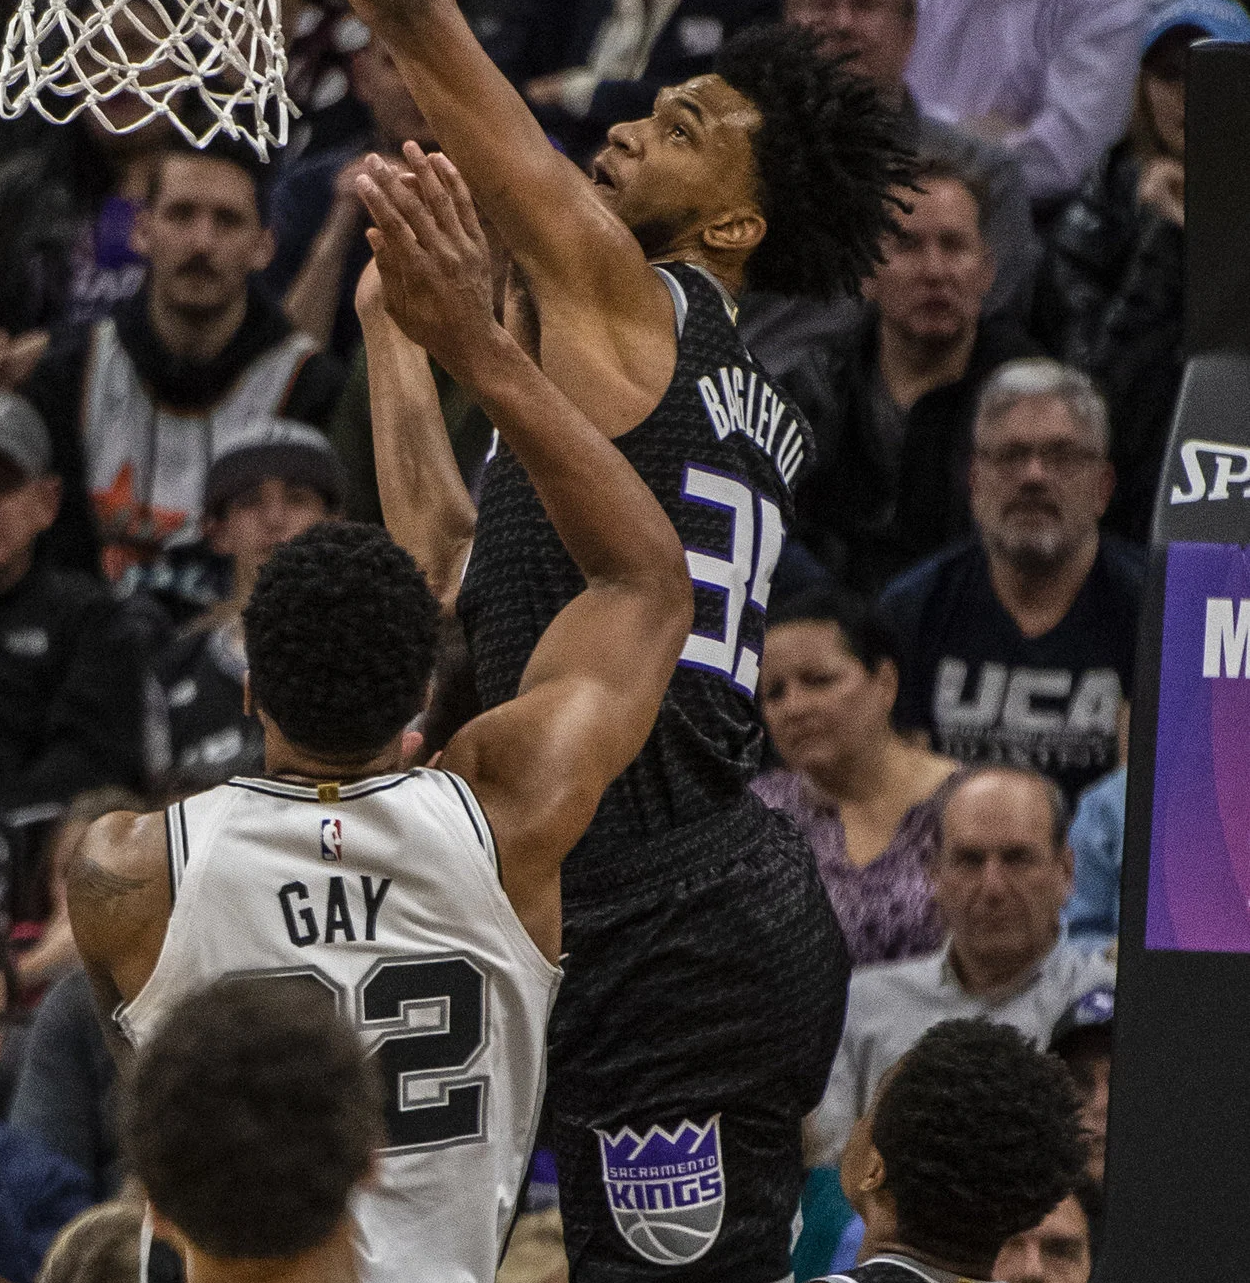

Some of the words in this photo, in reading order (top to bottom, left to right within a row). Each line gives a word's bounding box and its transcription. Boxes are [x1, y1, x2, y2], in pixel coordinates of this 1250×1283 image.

[697, 366, 786, 457] BAGLEY
[1170, 439, 1250, 505] SP
[934, 656, 1122, 736] UCA
[278, 875, 393, 948] GAY
[609, 1155, 716, 1179] SACRAMENTO
[609, 1171, 723, 1210] KINGS
